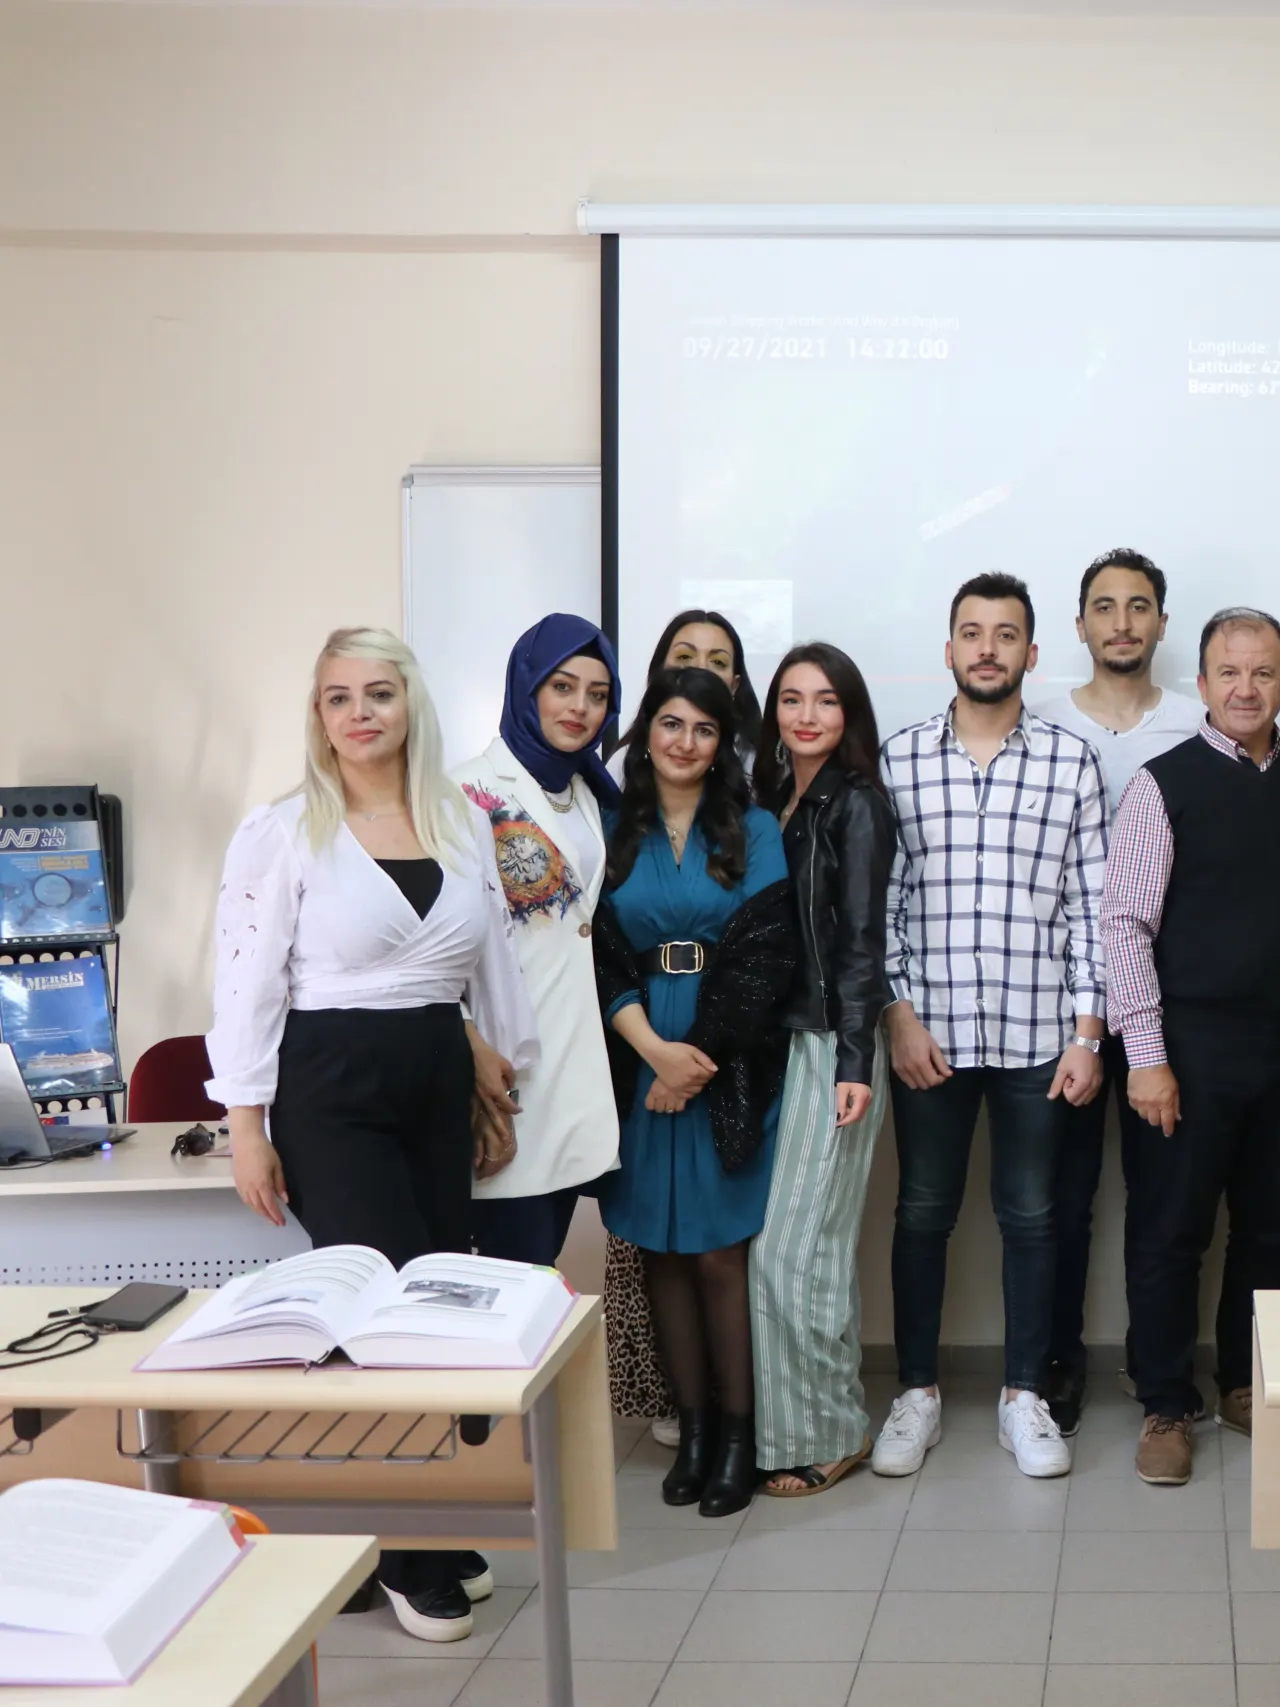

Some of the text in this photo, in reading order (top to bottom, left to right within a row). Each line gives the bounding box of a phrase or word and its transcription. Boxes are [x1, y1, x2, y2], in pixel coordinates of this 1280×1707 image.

[683, 336, 825, 361] 09/27/2021
[1188, 338, 1270, 357] Longitude:
[1188, 359, 1257, 374] Latitude:
[1188, 379, 1254, 398] Bearing:
